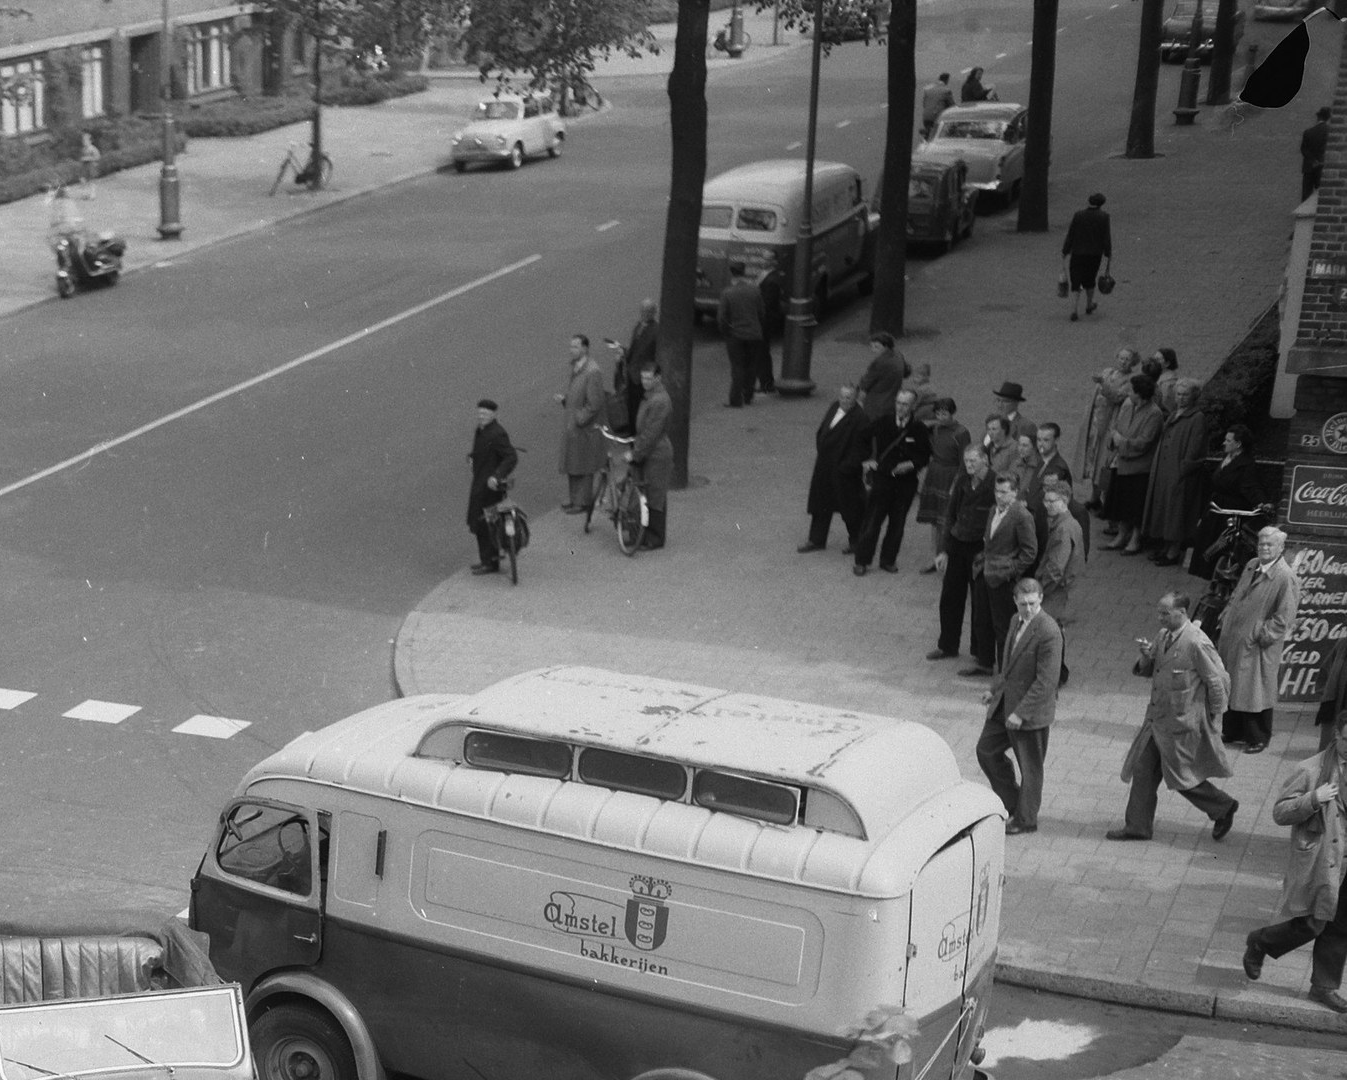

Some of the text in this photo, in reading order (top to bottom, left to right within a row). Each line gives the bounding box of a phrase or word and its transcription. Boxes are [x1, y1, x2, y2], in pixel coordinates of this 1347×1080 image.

[1301, 434, 1320, 447] 25
[544, 901, 617, 938] Amstel
[580, 938, 668, 976] bakkerijen
